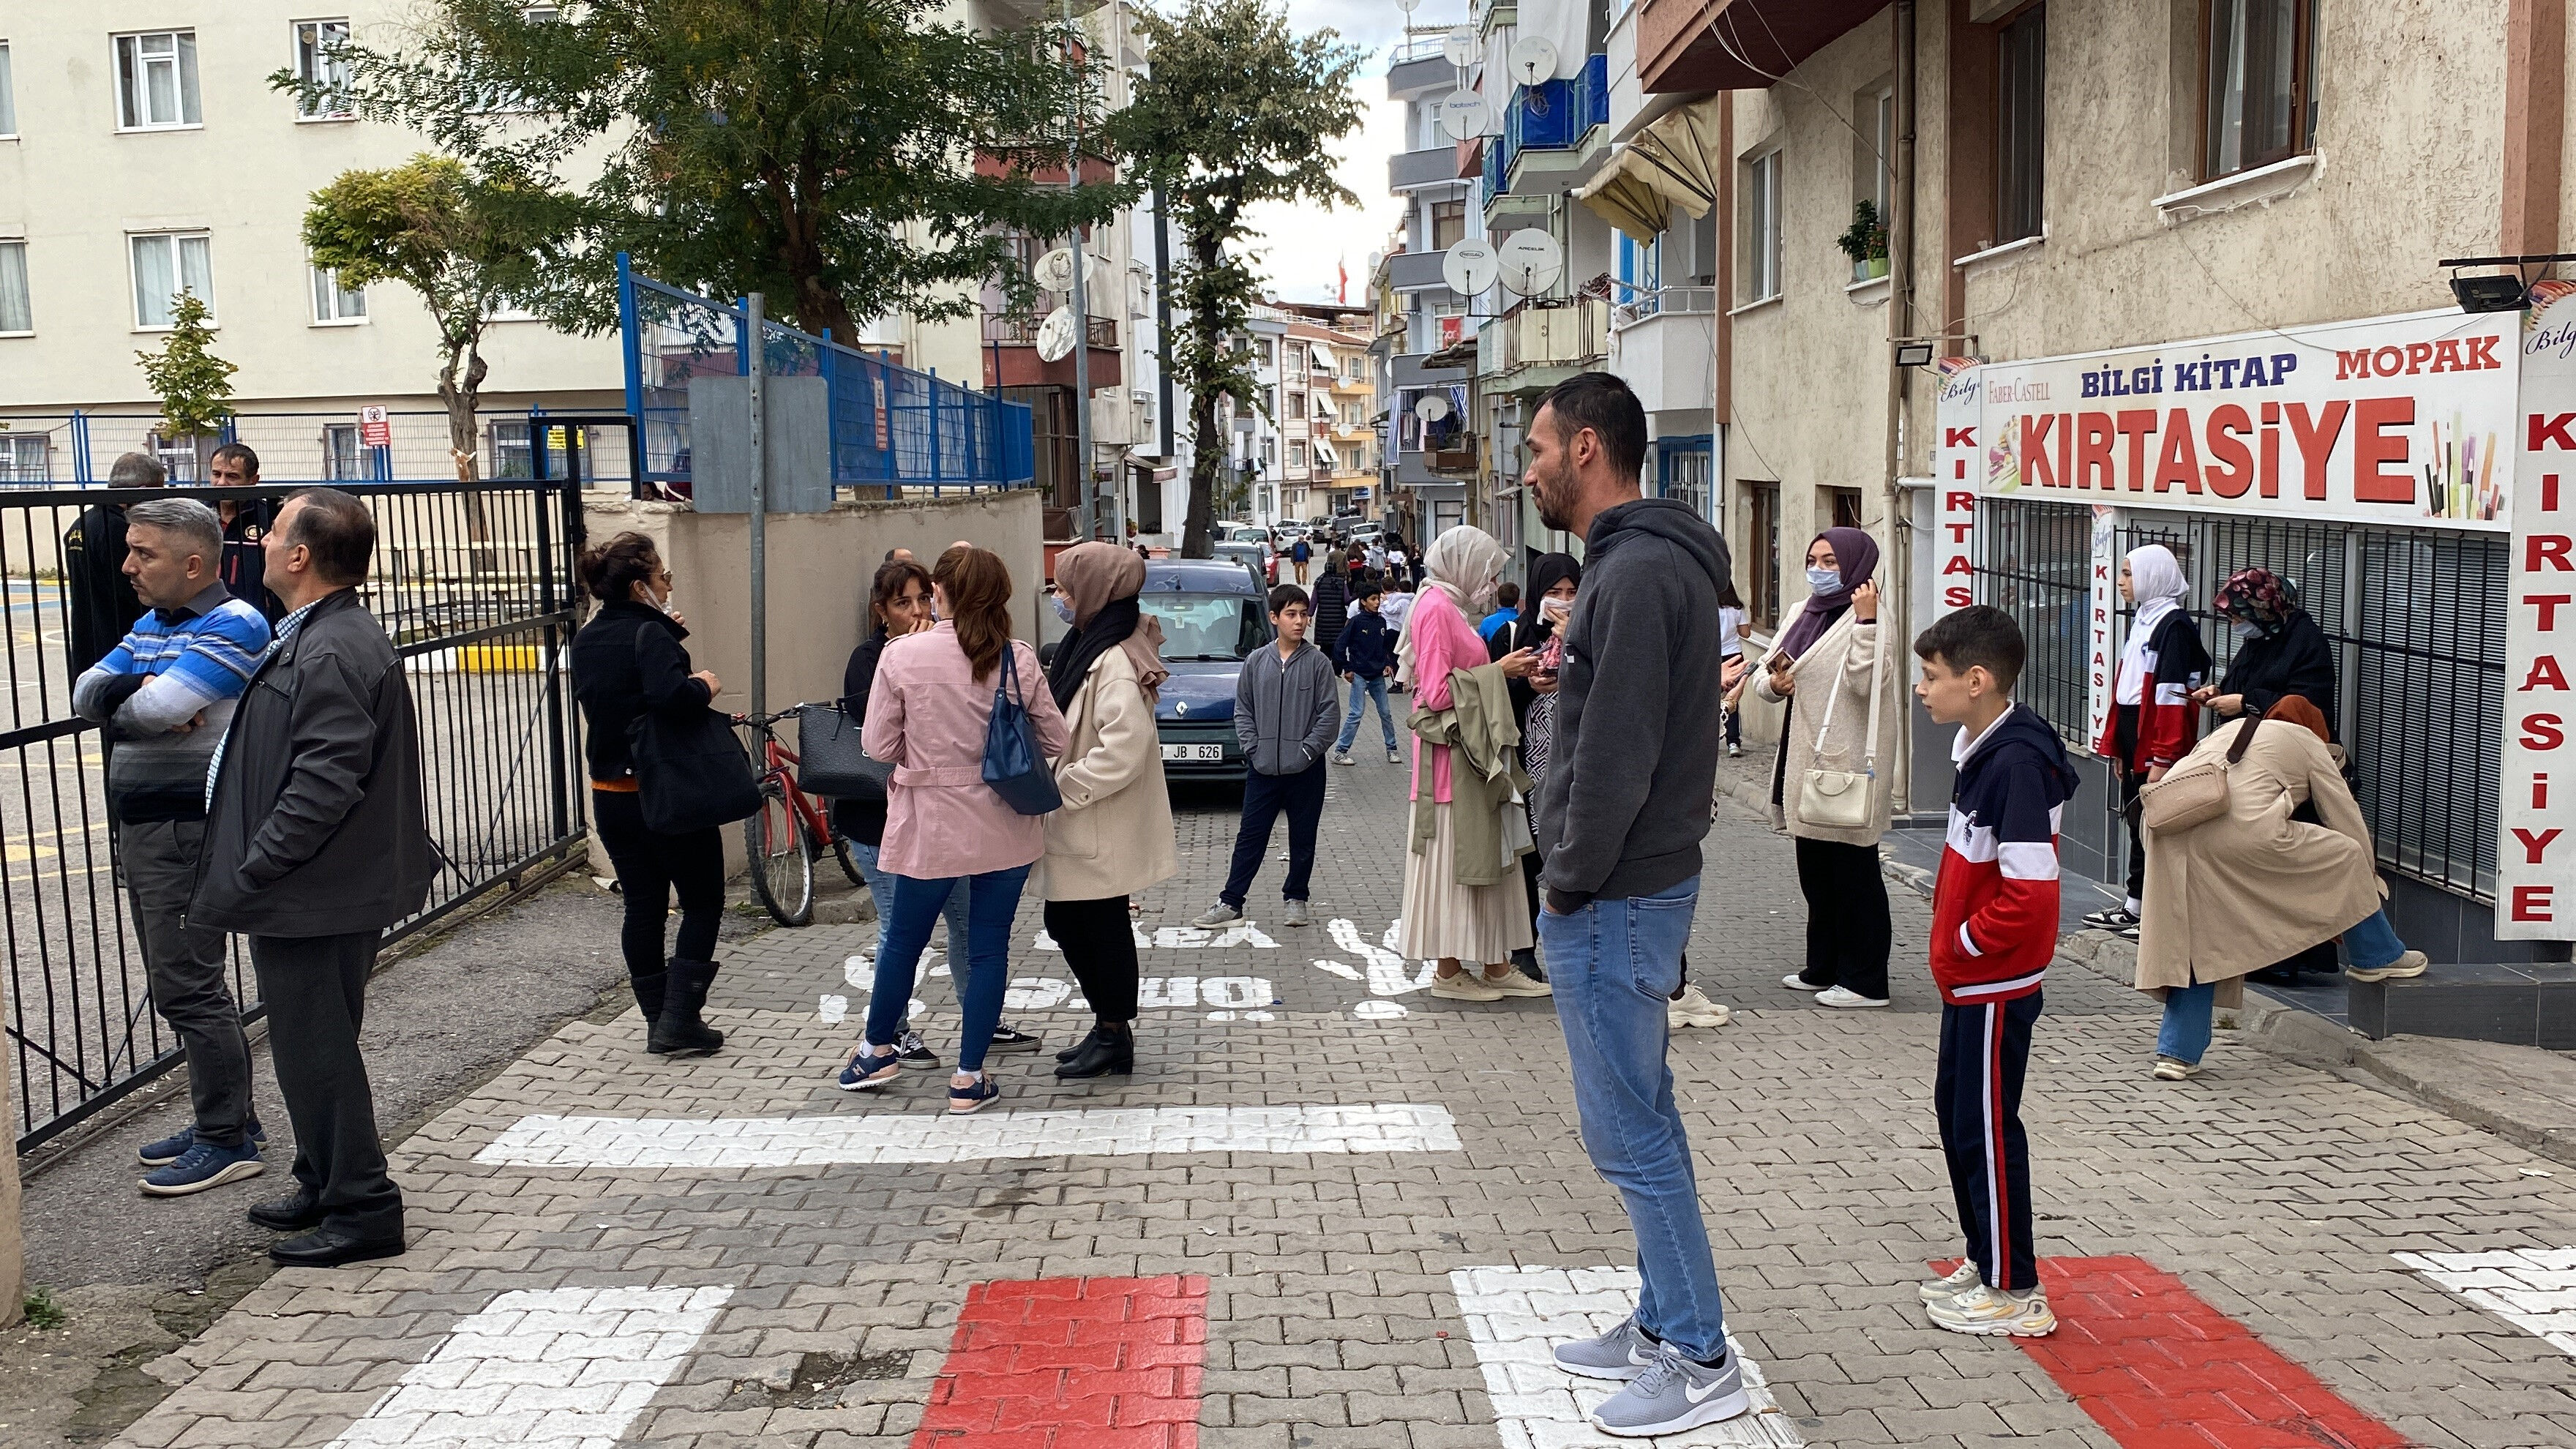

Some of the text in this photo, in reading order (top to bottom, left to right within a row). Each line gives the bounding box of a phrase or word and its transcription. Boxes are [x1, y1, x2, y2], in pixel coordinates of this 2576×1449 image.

[2336, 336, 2501, 381] MOPAK
[2525, 321, 2576, 359] Bilg
[2081, 353, 2297, 398] BİLGİ KİTAP
[1942, 427, 1978, 607] KIRTAS
[1174, 746, 1187, 758] JB
[1199, 746, 1219, 758] 626
